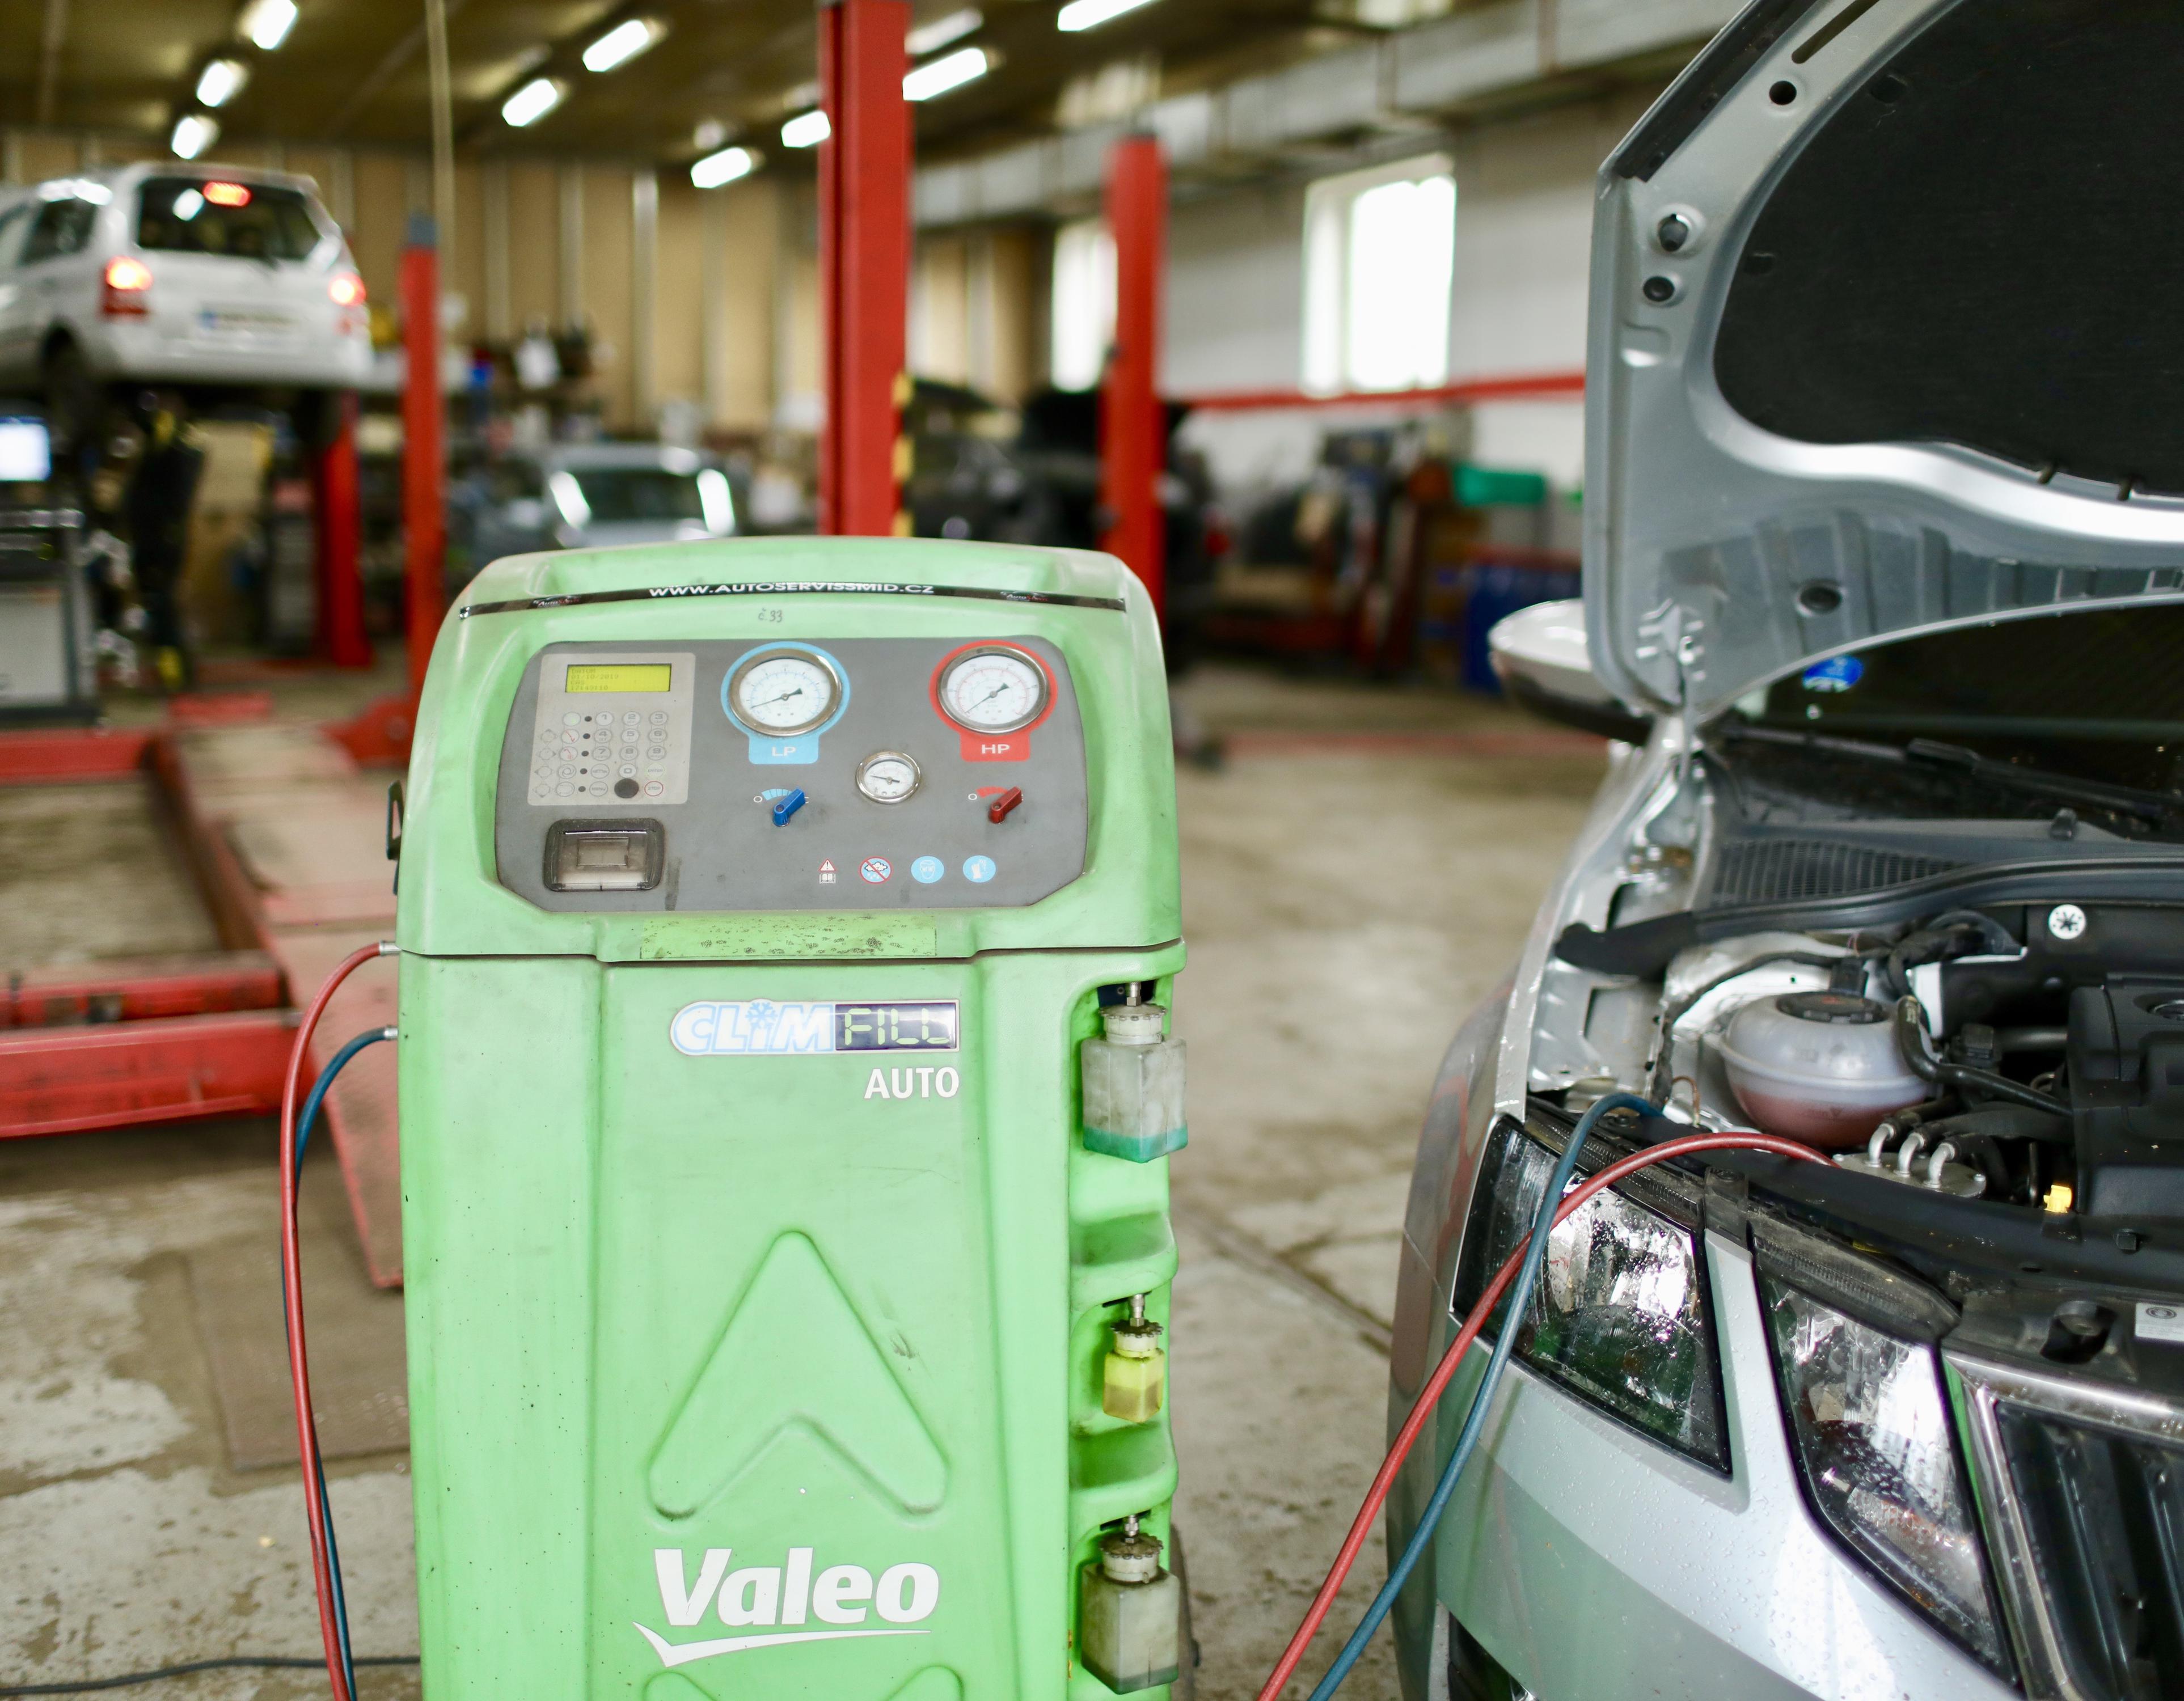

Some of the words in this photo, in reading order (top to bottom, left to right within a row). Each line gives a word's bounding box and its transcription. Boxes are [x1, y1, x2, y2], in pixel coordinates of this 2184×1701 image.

[649, 582, 935, 596] WWW.AUTOSERVISSMID.CZ
[772, 747, 796, 757] LP
[981, 744, 1010, 754] HP
[864, 1067, 960, 1099] AUTO
[654, 1547, 940, 1626] Valeo
